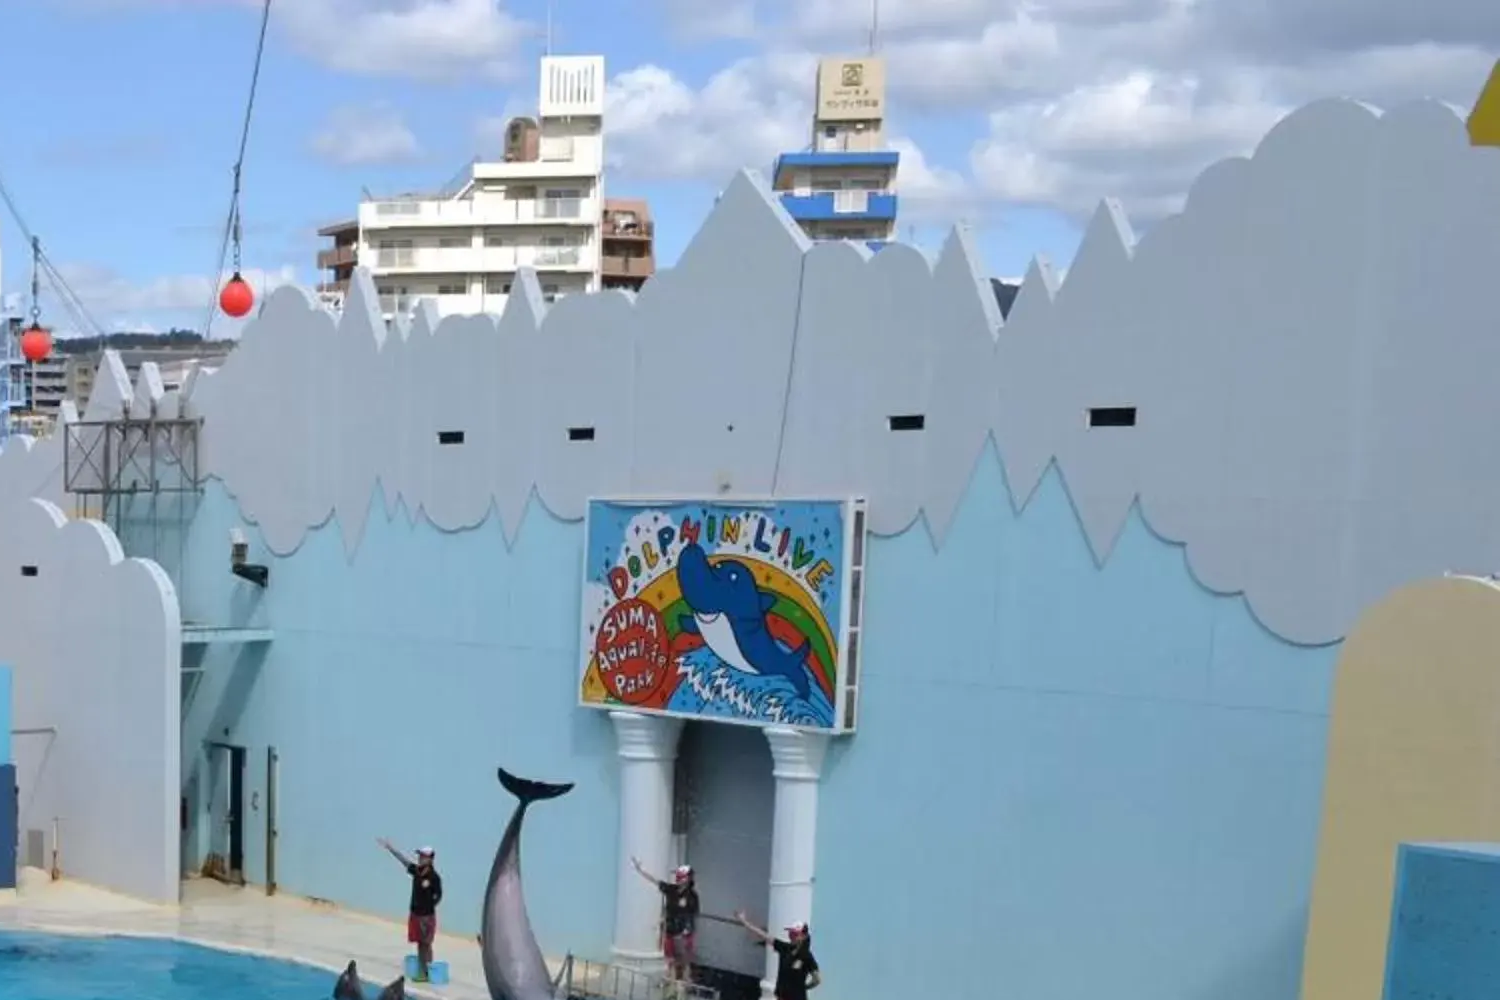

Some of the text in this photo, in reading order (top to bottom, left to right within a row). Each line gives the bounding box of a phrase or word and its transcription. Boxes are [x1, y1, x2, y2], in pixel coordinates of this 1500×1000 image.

[607, 514, 834, 600] DOLPHIN LIVE
[603, 605, 658, 643] SUMA
